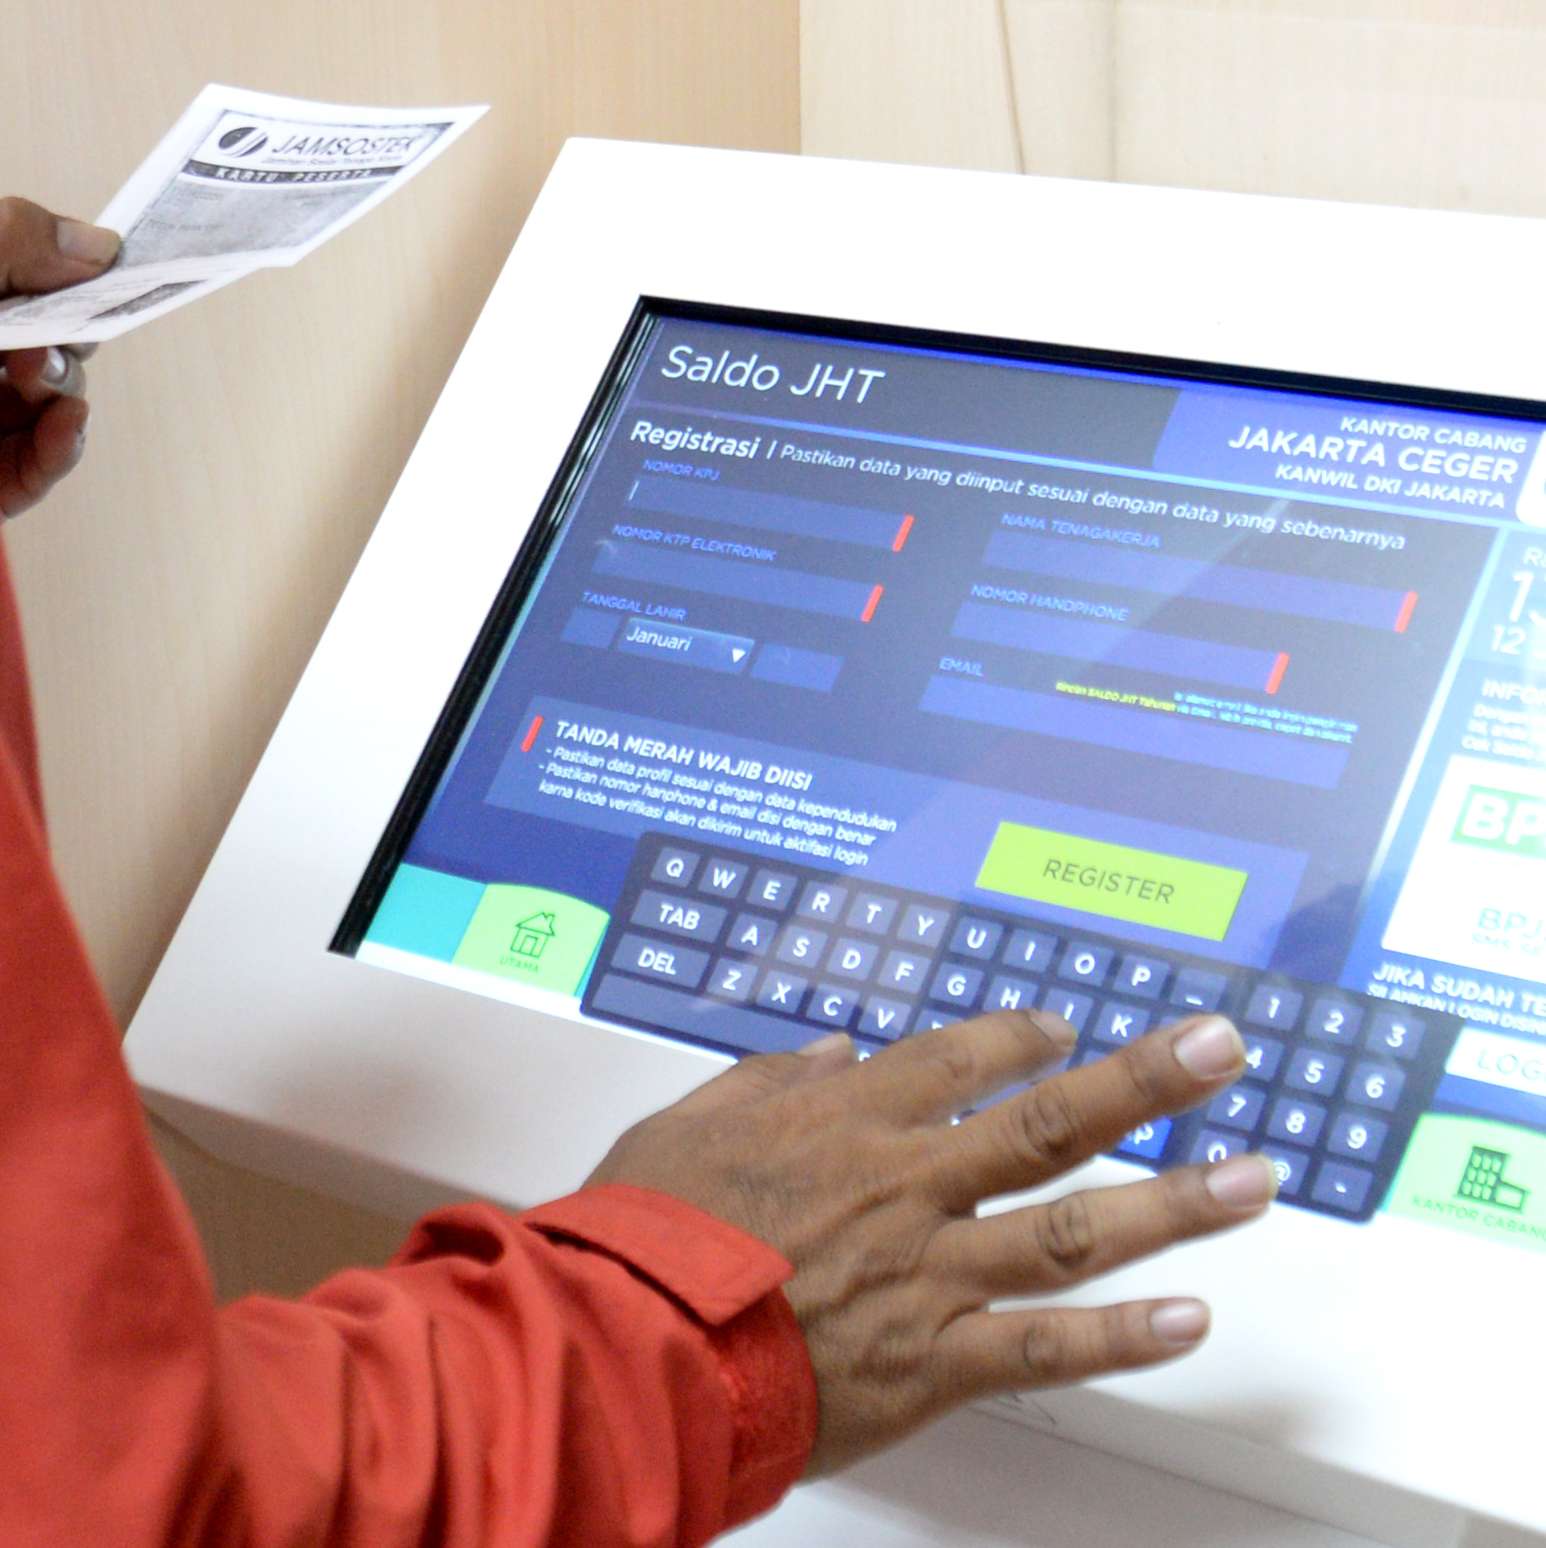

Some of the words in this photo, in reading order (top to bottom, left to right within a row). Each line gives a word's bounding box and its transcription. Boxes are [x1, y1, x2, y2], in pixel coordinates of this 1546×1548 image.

[271, 134, 420, 156] JAMSOSTEK
[215, 167, 278, 183] KARTU
[293, 169, 372, 183] PESERTA
[661, 345, 780, 391] Saldo
[790, 363, 885, 403] JHT
[1228, 426, 1386, 468] JAKARTA
[1397, 447, 1519, 484] CEGER
[1341, 416, 1430, 441] KANTOR
[1433, 428, 1527, 454] CABANG
[631, 420, 763, 459] Registrasi
[780, 445, 855, 469] Pastikan
[859, 458, 900, 476] data
[905, 466, 951, 486] yang
[956, 470, 1024, 496] diinput
[1027, 483, 1089, 505] sesuai
[1092, 490, 1167, 515] dengan
[1172, 500, 1218, 522] data
[1223, 510, 1276, 534] yang
[1280, 516, 1405, 551] sebenarnya
[643, 459, 692, 476] NOMOR
[694, 466, 721, 481] KPJ
[1275, 464, 1358, 490] KANWIL
[1363, 475, 1402, 494] DKI
[1404, 481, 1505, 509] JAKARTA
[613, 523, 662, 543] NOMOR
[664, 531, 691, 548] KTP
[692, 538, 776, 562] ELEKTRONIK
[1001, 512, 1046, 532] NAMA
[1051, 518, 1161, 549] TENAGAKERJA
[582, 590, 643, 614] TANGGAL
[645, 604, 687, 621] LAHIR
[971, 584, 1029, 605] NOMOR
[1030, 592, 1129, 623] HANDPHONE
[626, 626, 693, 652] Januari
[1491, 625, 1526, 655] 12
[939, 657, 984, 678] EMAIL
[555, 719, 619, 750] TANDA
[622, 734, 695, 765] MERAH
[697, 750, 763, 780] WAJIB
[764, 765, 814, 792] DIISI
[546, 762, 599, 785] Pastikan
[599, 776, 641, 795] nomor
[641, 783, 705, 812] hanphone
[706, 799, 718, 813] &
[719, 802, 756, 821] email
[757, 810, 782, 828] disi
[782, 815, 834, 839] dengan
[834, 826, 876, 847] benar
[553, 746, 604, 769] Pastikan
[606, 758, 636, 776] data
[636, 764, 671, 784] profil
[671, 773, 713, 793] sesuai
[713, 780, 763, 805] dengan
[764, 792, 796, 812] data
[796, 799, 898, 833] kependudukan
[538, 780, 574, 798] karna
[575, 788, 608, 806] kode
[609, 795, 664, 820] verifikasi
[664, 808, 696, 827] akan
[697, 816, 743, 838] dikirim
[743, 827, 783, 847] untuk
[783, 835, 832, 858] aktifasi
[833, 845, 869, 866] login
[1043, 858, 1174, 904] REGISTER
[500, 956, 539, 974] UTAMA
[666, 858, 685, 879] Q
[712, 868, 737, 890] W
[763, 880, 782, 902] E
[812, 891, 832, 913] R
[866, 904, 882, 924] T
[917, 915, 935, 937] Y
[965, 927, 987, 950] U
[1025, 941, 1036, 962] I
[1074, 952, 1096, 976] O
[1131, 964, 1151, 987] P
[1268, 997, 1281, 1019] 1
[1324, 1012, 1344, 1034] 2
[1386, 1026, 1407, 1048] 3
[658, 903, 702, 931] TAB
[741, 925, 759, 947] A
[793, 937, 811, 958] S
[842, 949, 861, 971] D
[895, 963, 915, 983] F
[947, 975, 967, 998] G
[1000, 988, 1021, 1010] H
[1111, 1014, 1133, 1038] K
[1245, 1046, 1264, 1070] 4
[1304, 1060, 1326, 1084] 5
[1365, 1074, 1385, 1099] 6
[1372, 962, 1425, 990] JIKA
[1431, 974, 1516, 1008] SUDAH
[637, 947, 678, 976] DEL
[722, 970, 742, 992] Z
[771, 982, 793, 1005] X
[822, 996, 843, 1018] C
[876, 1007, 896, 1031] V
[1227, 1094, 1247, 1117] 7
[1285, 1110, 1307, 1134] 8
[1346, 1126, 1368, 1150] 9
[1411, 1194, 1479, 1222] KANTOR
